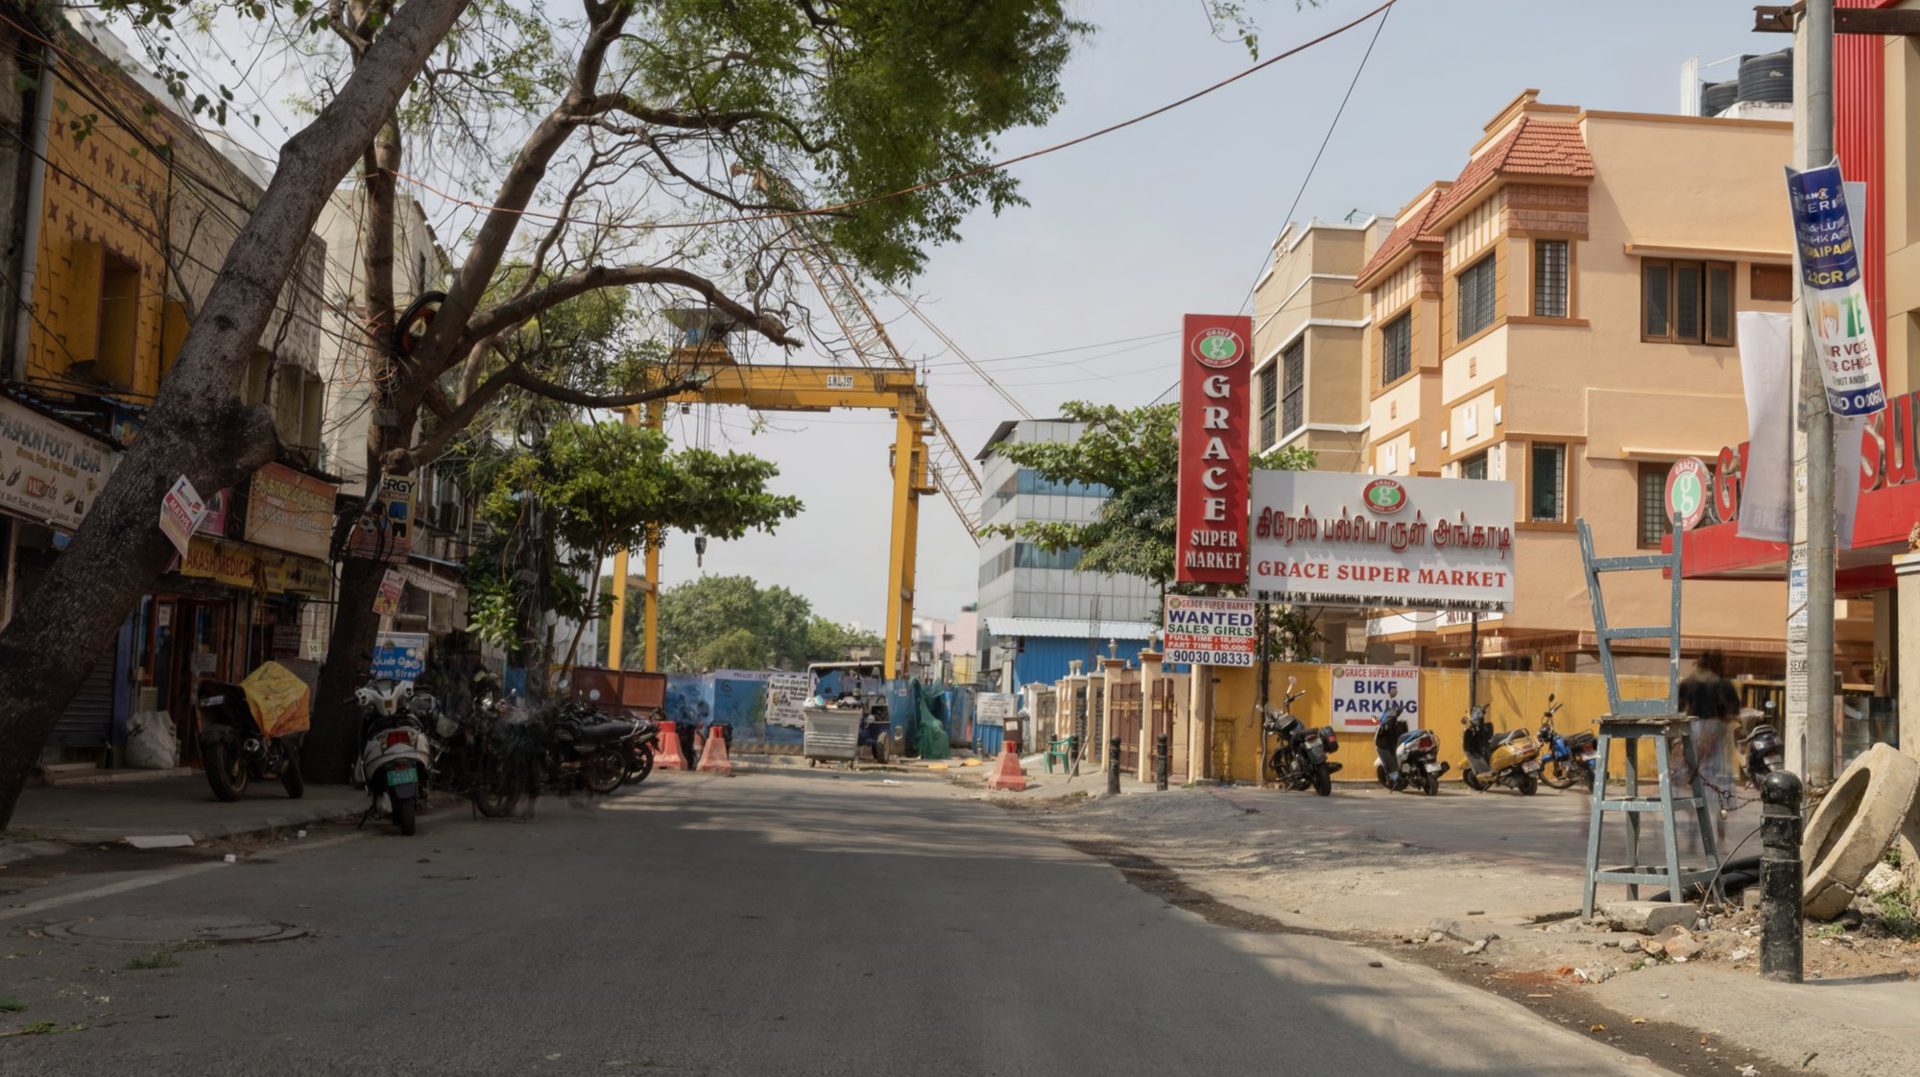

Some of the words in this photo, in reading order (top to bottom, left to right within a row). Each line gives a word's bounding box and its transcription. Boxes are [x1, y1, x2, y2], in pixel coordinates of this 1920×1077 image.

[1202, 374, 1231, 521] GRACE
[1190, 529, 1238, 547] SUPER
[1257, 505, 1318, 544] கிரேஸ்
[1324, 506, 1427, 551] பல்பொருள்
[1433, 511, 1511, 559] அங்காடி
[186, 550, 216, 573] AKASH
[1184, 552, 1242, 569] MARKET
[1257, 560, 1329, 579] GRACE
[1337, 564, 1410, 583] SUPER
[1417, 568, 1507, 587] MARKET
[1182, 599, 1203, 609] GRACE
[1204, 601, 1226, 610] SUPER
[1227, 602, 1253, 611] MARKET
[1168, 610, 1253, 626] WANTED
[1168, 624, 1209, 634] SALES
[1213, 626, 1253, 637] GIRLS
[1173, 650, 1210, 663] 90030
[1213, 652, 1250, 665] 08333
[1345, 668, 1367, 677] GRACE
[1368, 669, 1390, 678] SUPER
[1391, 670, 1418, 678] MARKET
